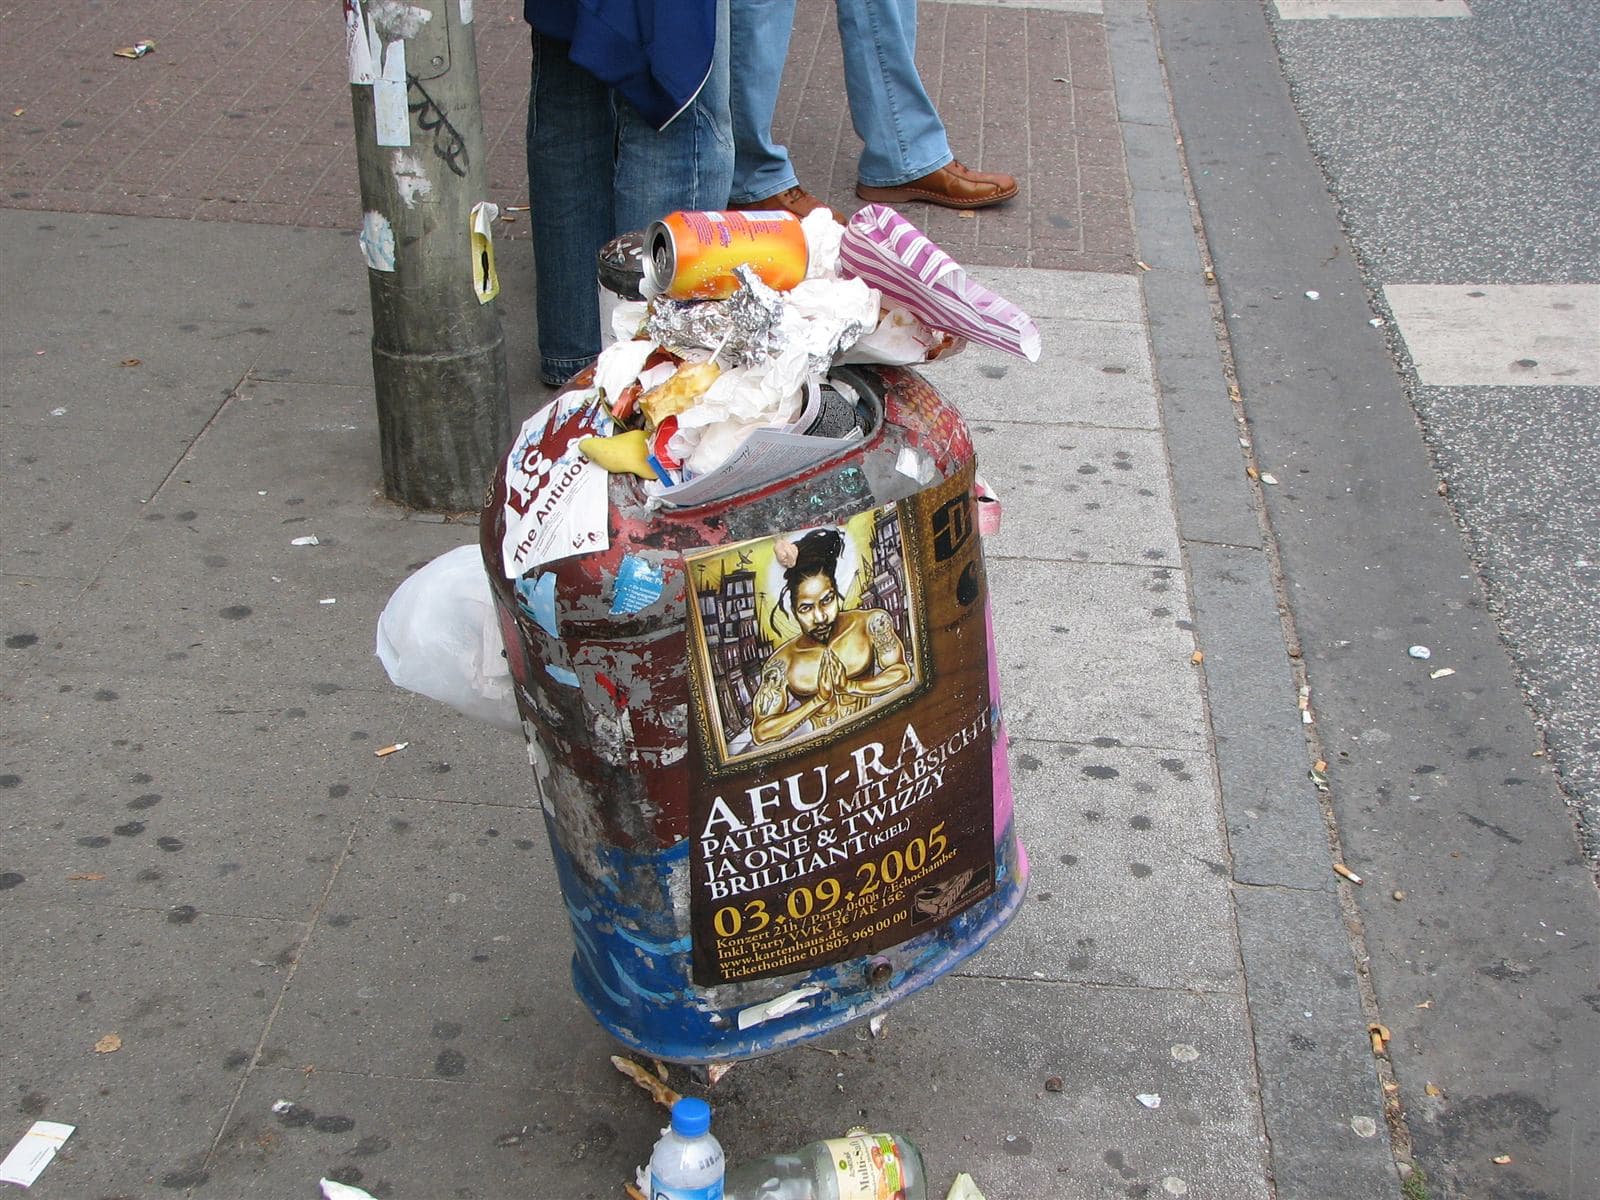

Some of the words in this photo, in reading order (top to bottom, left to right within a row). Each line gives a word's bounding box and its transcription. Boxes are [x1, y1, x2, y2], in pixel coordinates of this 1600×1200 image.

[514, 528, 537, 565] The
[536, 455, 590, 525] Antidot
[700, 723, 929, 839] AFU-RA
[701, 803, 833, 859] PATRICK
[836, 774, 889, 817] MIT
[896, 707, 990, 790] ABSICHT
[705, 858, 734, 886] JA
[744, 835, 811, 870] ONE
[817, 828, 838, 847] &
[841, 765, 946, 836] TWIZZY
[711, 832, 869, 901] BRILLIANT
[868, 817, 911, 849] (KIEL)
[713, 820, 949, 938] 03.09.2005
[716, 931, 770, 950] Konzert
[773, 920, 798, 936] 21h
[811, 907, 843, 924] Party
[846, 892, 880, 912] 0:00h
[890, 848, 958, 893] Echochamber
[717, 946, 749, 959] Inkl.
[752, 938, 786, 952] Party
[789, 924, 823, 941] VVK
[720, 951, 807, 979] Tickethotline
[809, 935, 850, 957] 01805
[852, 925, 875, 942] 969
[876, 918, 890, 932] 00
[893, 909, 907, 921] 00
[720, 929, 843, 970] www.kartenhaus.de
